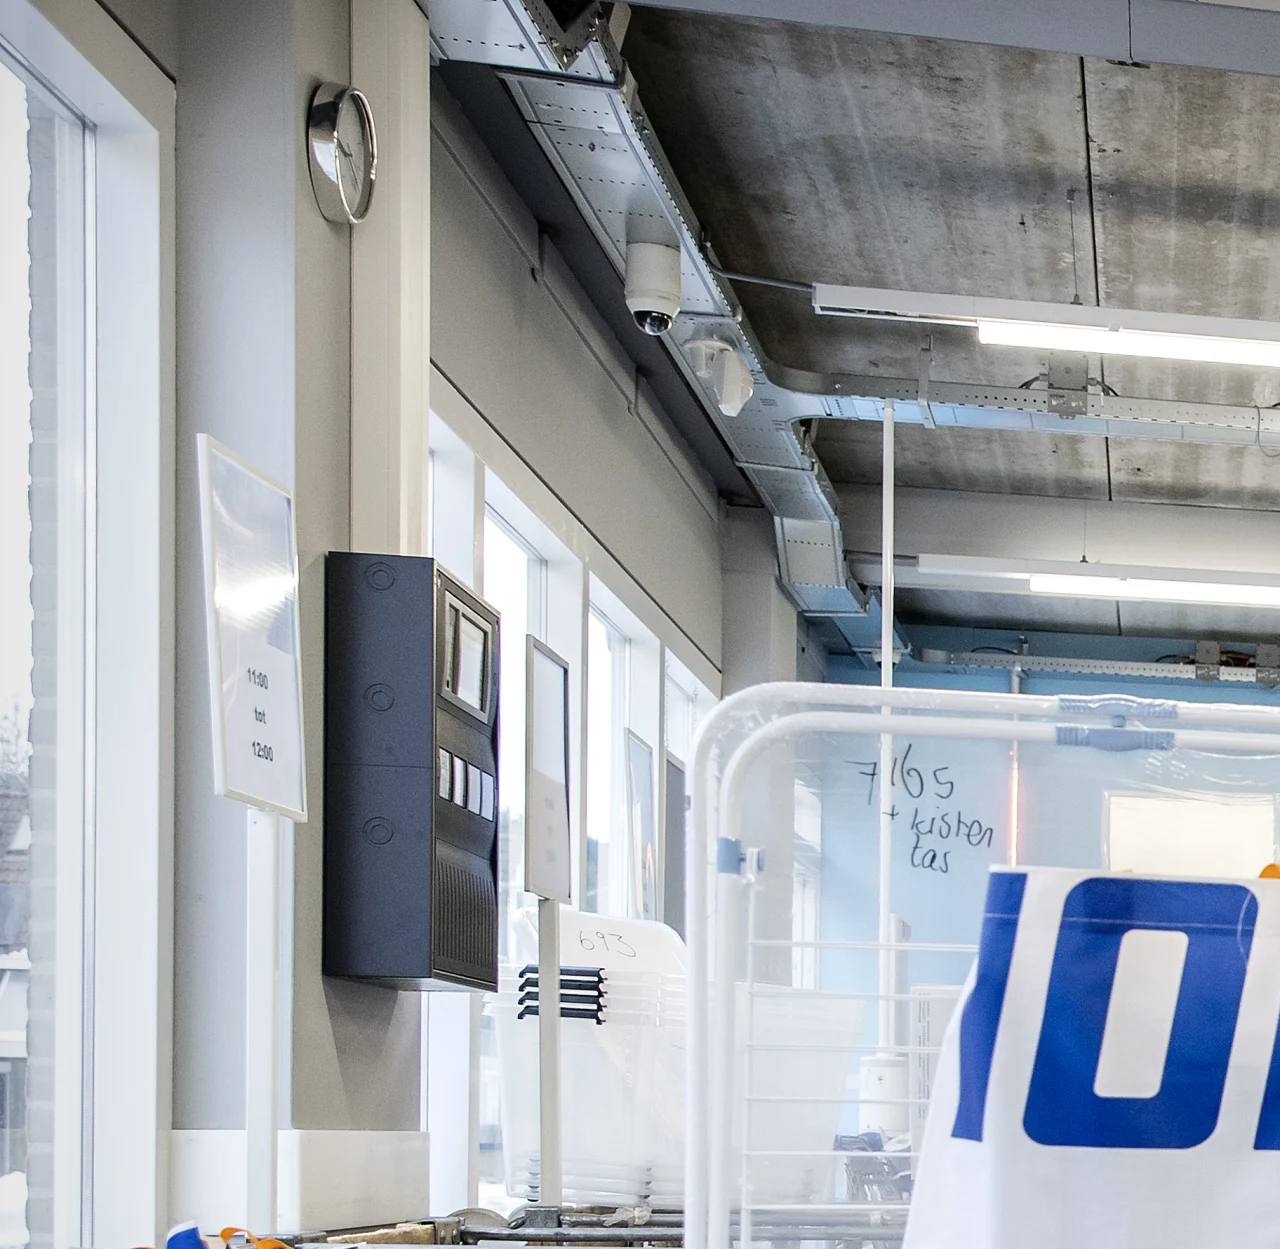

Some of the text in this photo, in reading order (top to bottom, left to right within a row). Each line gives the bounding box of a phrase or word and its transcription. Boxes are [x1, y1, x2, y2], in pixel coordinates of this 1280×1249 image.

[248, 668, 268, 689] 11:00
[254, 706, 266, 724] tot
[252, 741, 273, 761] 12:00
[844, 744, 954, 805] 7165
